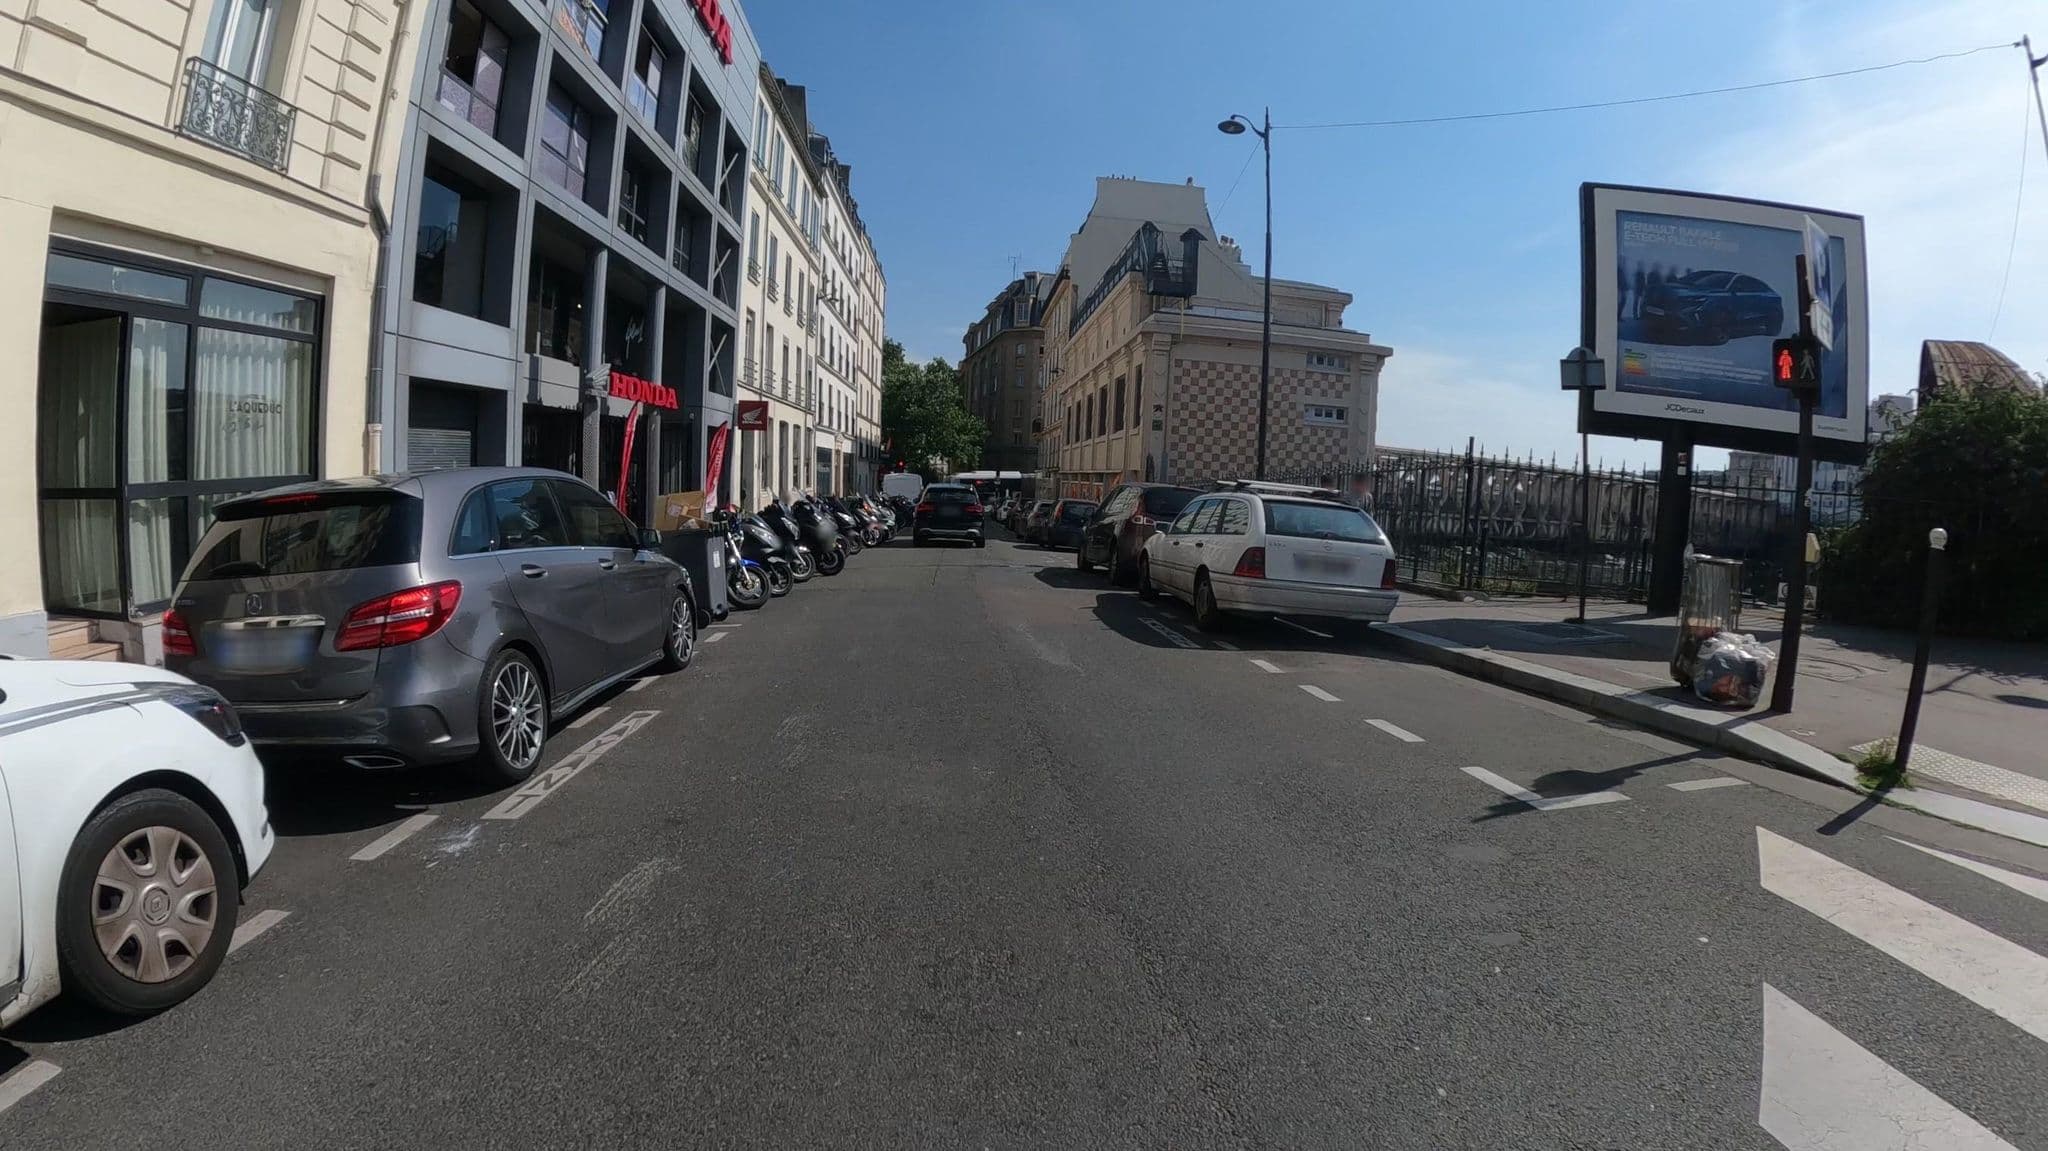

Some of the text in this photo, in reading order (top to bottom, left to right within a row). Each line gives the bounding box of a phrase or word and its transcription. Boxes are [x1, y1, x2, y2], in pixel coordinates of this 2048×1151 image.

[611, 371, 679, 410] HONDA
[229, 400, 282, 414] L'AQUEDUC
[1664, 403, 1704, 414] JCDecaux
[494, 711, 656, 817] PAYANT
